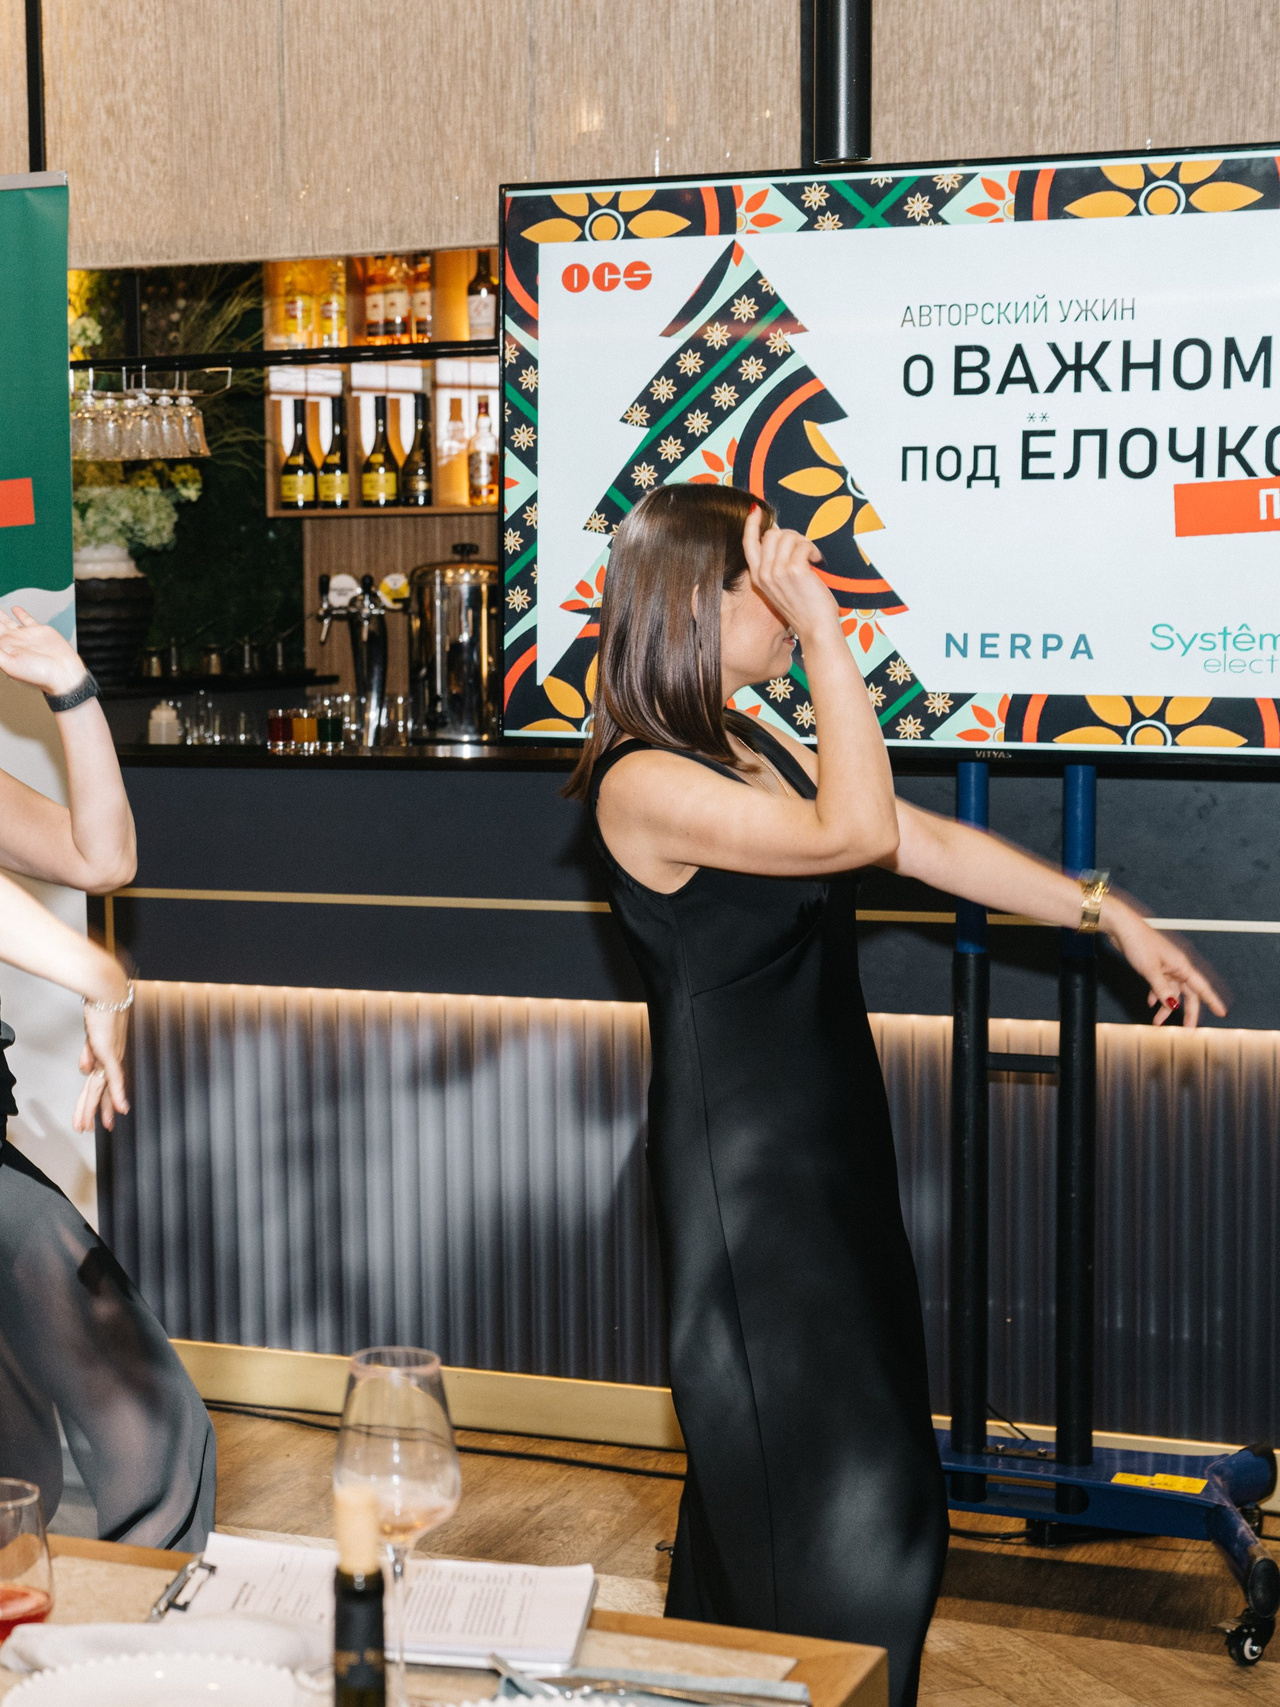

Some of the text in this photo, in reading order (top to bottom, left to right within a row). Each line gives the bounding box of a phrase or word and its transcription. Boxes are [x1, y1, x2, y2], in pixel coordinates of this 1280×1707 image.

[561, 260, 653, 294] OCS
[900, 293, 1137, 328] АВТОРСКИЙ УЖИН
[953, 335, 1274, 396] ВАЖНОМ
[900, 444, 1001, 489] под
[944, 632, 1095, 660] NERPA
